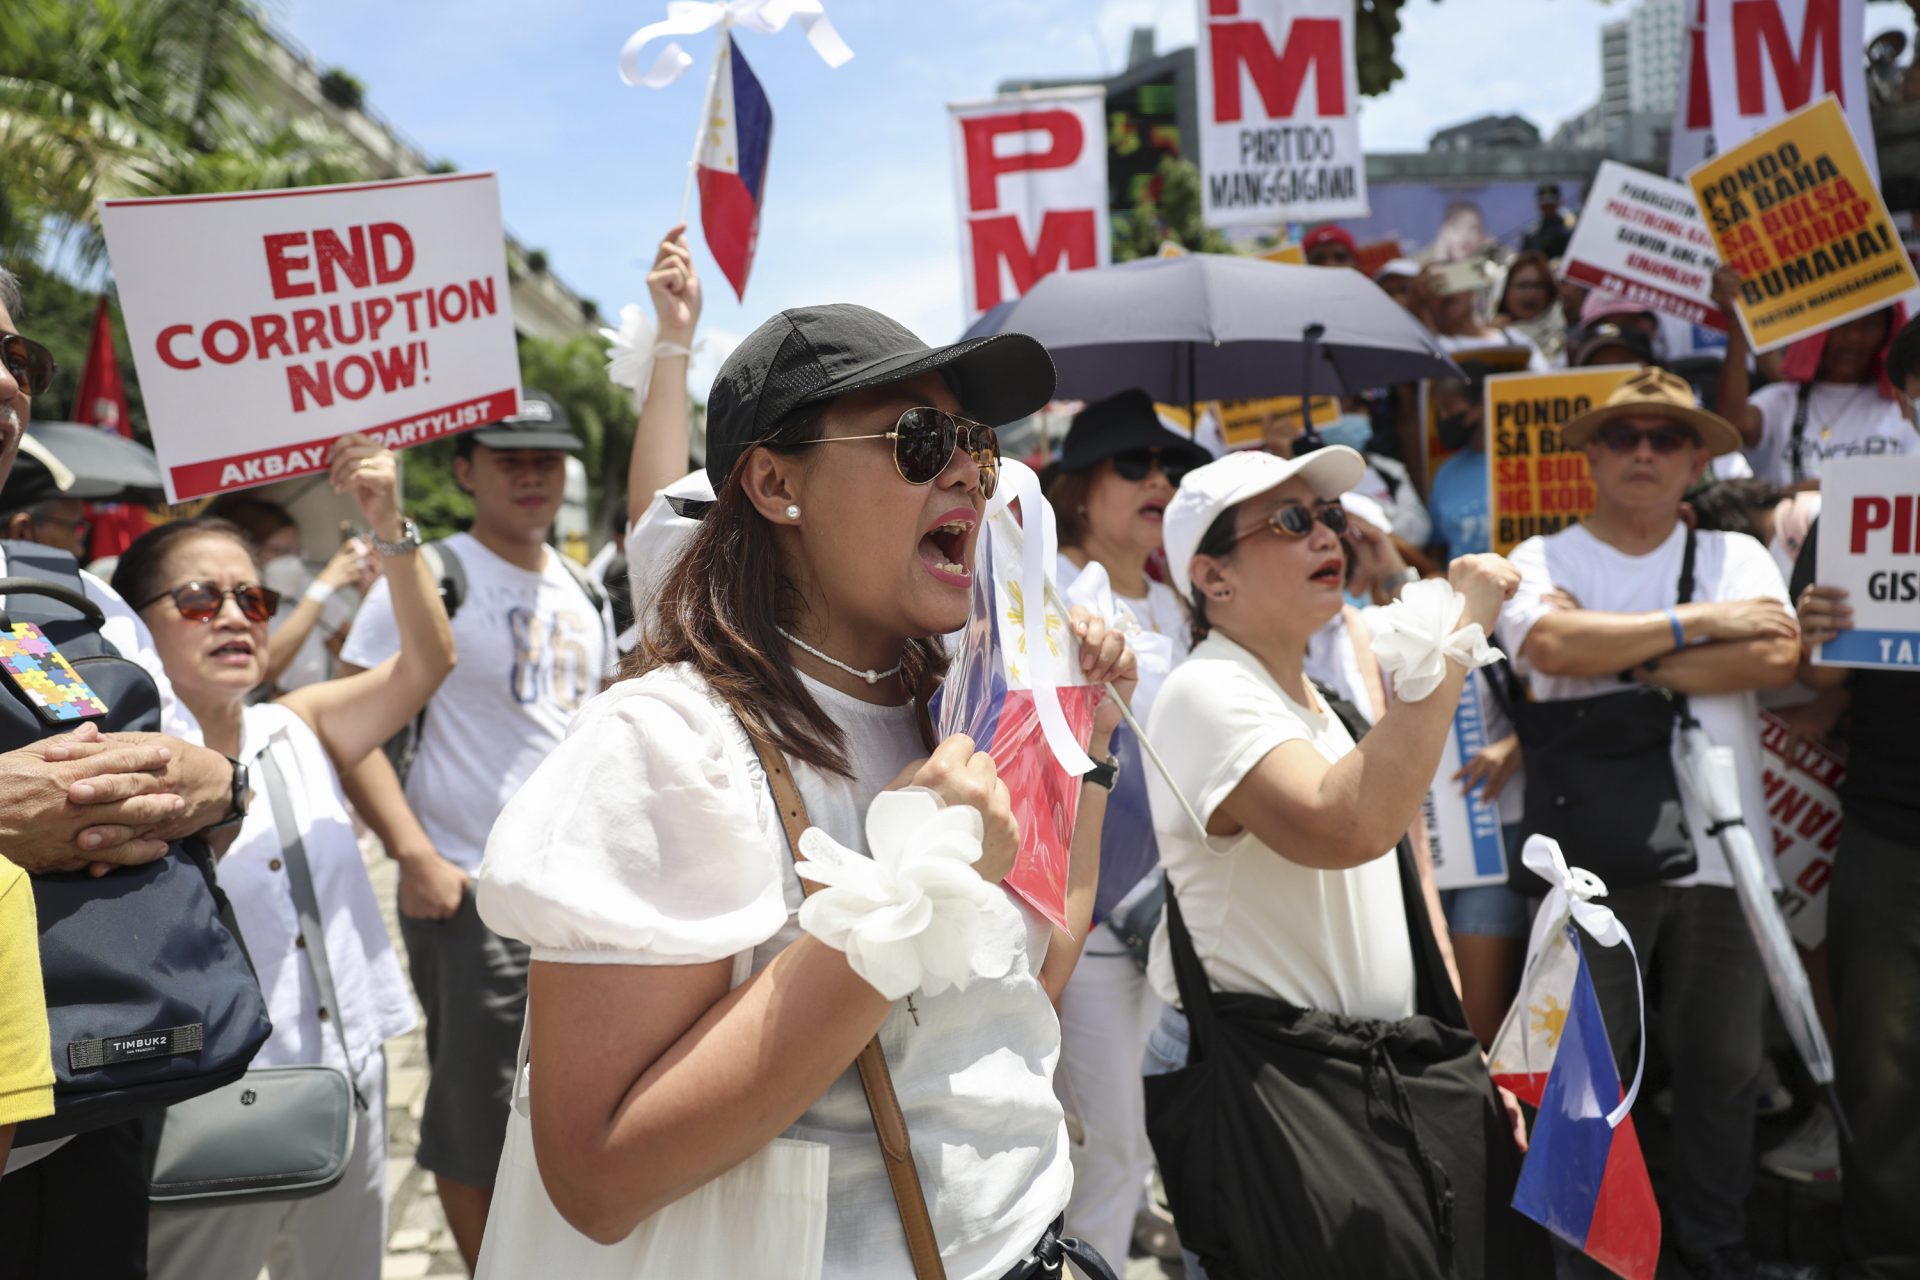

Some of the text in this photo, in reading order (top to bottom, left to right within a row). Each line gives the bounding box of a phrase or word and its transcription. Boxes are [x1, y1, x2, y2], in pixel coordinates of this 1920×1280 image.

[1210, 18, 1346, 123] M
[960, 109, 1084, 212] P
[1240, 126, 1335, 165] PARTIDO
[1702, 142, 1801, 208] PONDO
[1210, 166, 1358, 208] MANGGAGAWA
[1711, 154, 1840, 234] SA BAHA
[1719, 222, 1759, 254] SA
[1761, 177, 1858, 236] BULSA
[263, 221, 415, 300] END
[969, 209, 1097, 312] M
[1729, 199, 1872, 279] NG KORAP
[1741, 222, 1893, 305] BUMAHA!
[156, 277, 497, 370] CORRUPTION
[286, 341, 431, 413] NOW!
[1497, 395, 1592, 427] PONDO
[220, 401, 492, 487] AKBAY PARTYLIST
[1497, 430, 1530, 456] SA
[1497, 456, 1588, 484] SA BUL
[1498, 486, 1596, 513] NG KOR
[1850, 495, 1920, 556] PI
[1868, 571, 1920, 603] GIS
[1880, 638, 1920, 664] TA
[113, 1036, 167, 1051] TIMBUK2
